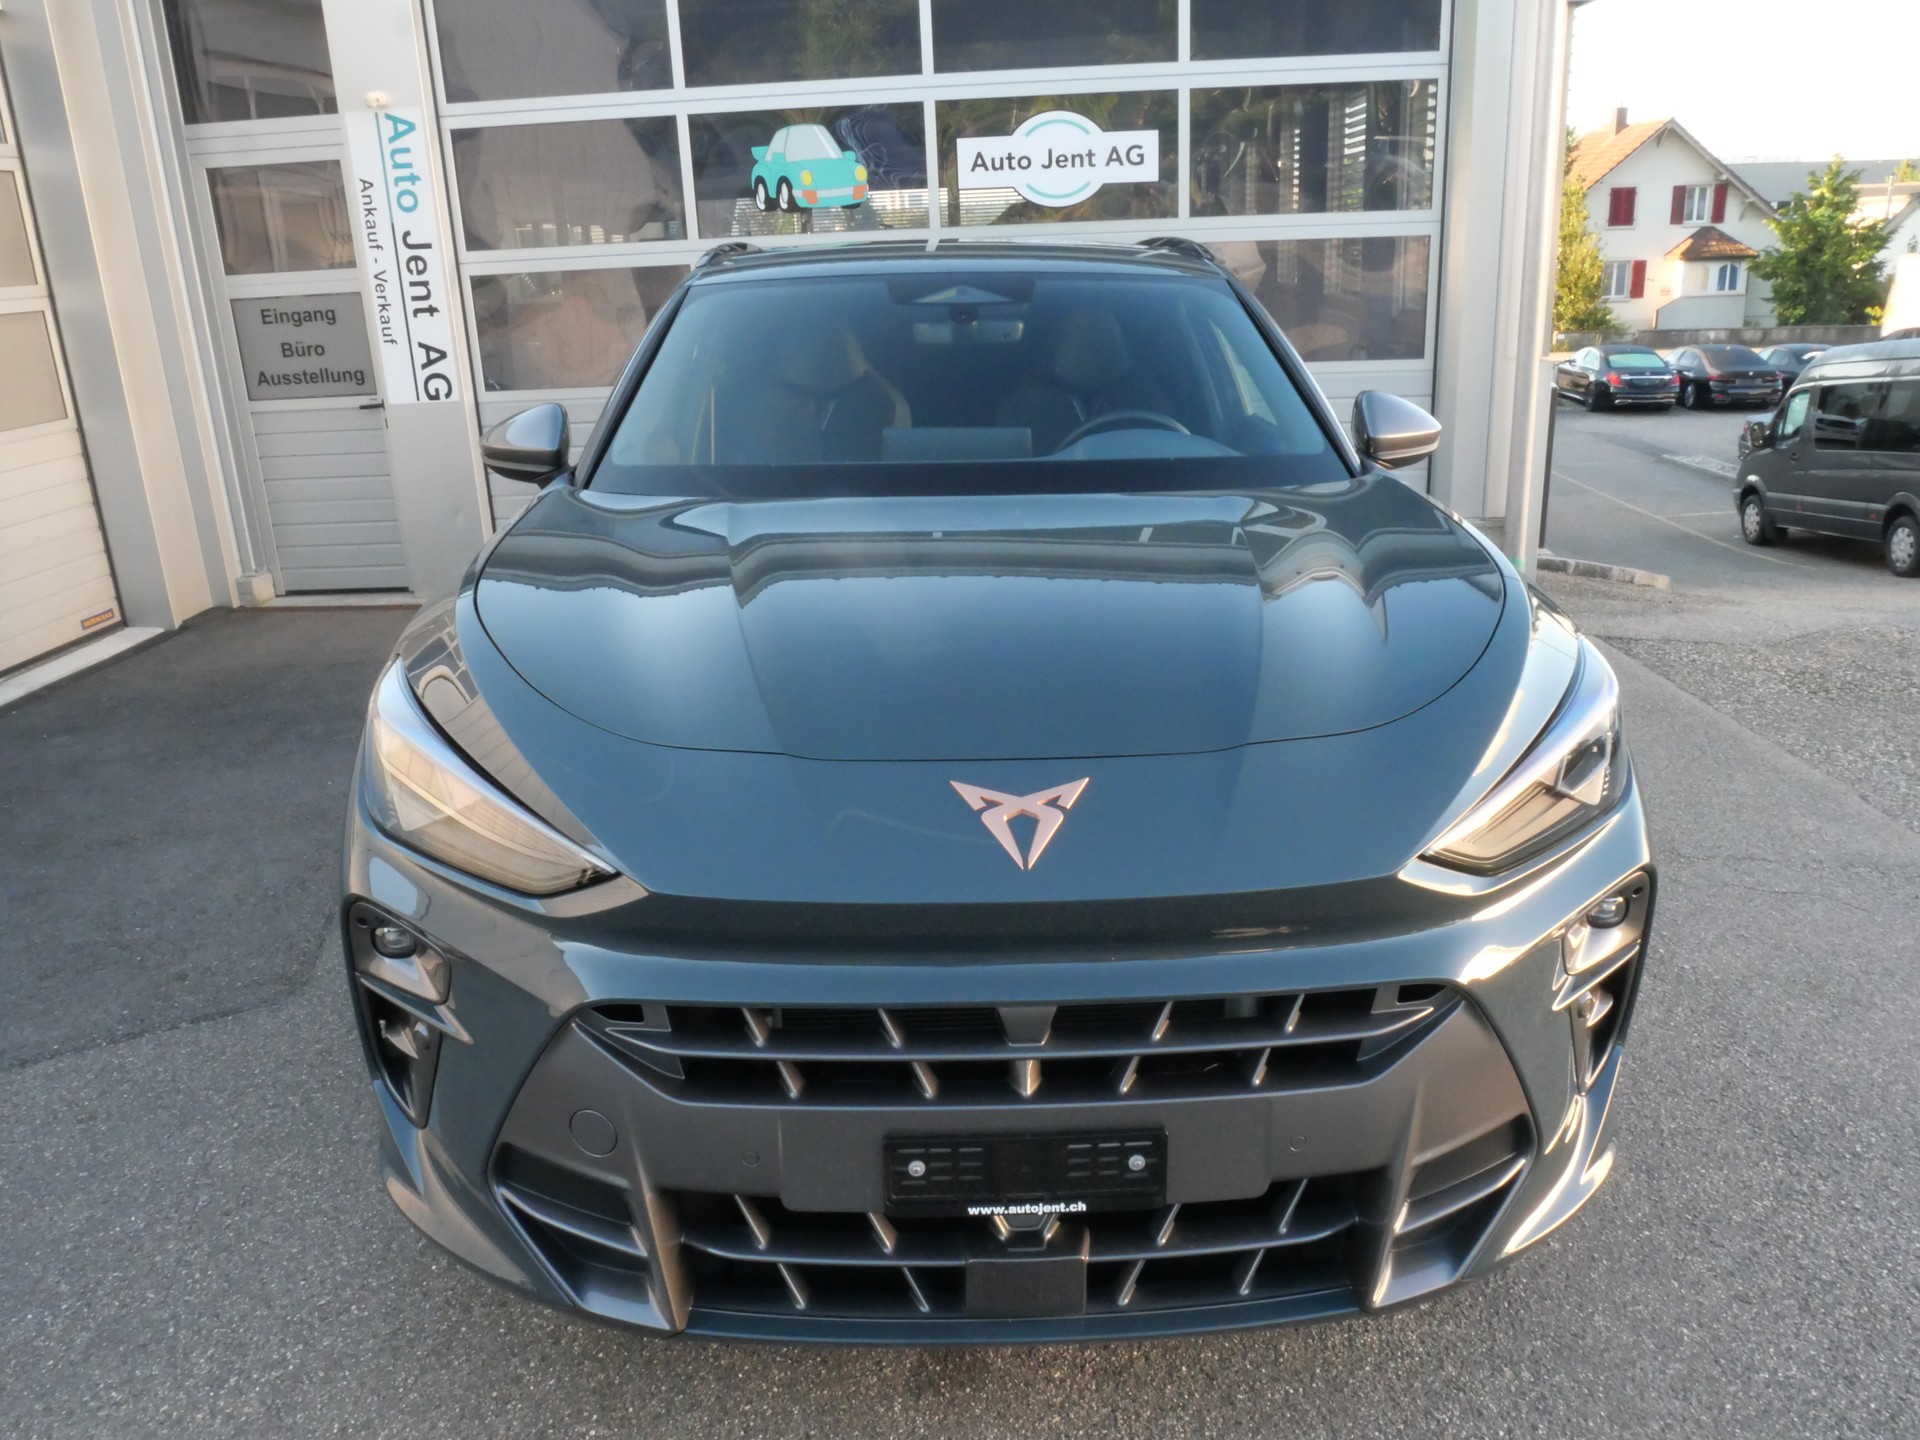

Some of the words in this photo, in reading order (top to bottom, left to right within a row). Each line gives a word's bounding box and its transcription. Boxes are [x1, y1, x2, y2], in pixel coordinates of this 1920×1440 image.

[384, 112, 422, 213] Auto
[970, 151, 1032, 172] Auto
[1041, 148, 1096, 169] Jent
[1105, 145, 1145, 167] AG
[359, 178, 384, 251] Ankauf
[373, 270, 398, 345] Verkauf
[402, 229, 440, 318] Jent
[260, 308, 337, 328] Eingang
[281, 341, 326, 359] Büro
[257, 367, 366, 387] Ausstellung
[418, 341, 453, 402] AG
[967, 1201, 1087, 1215] www.autojent.ch
